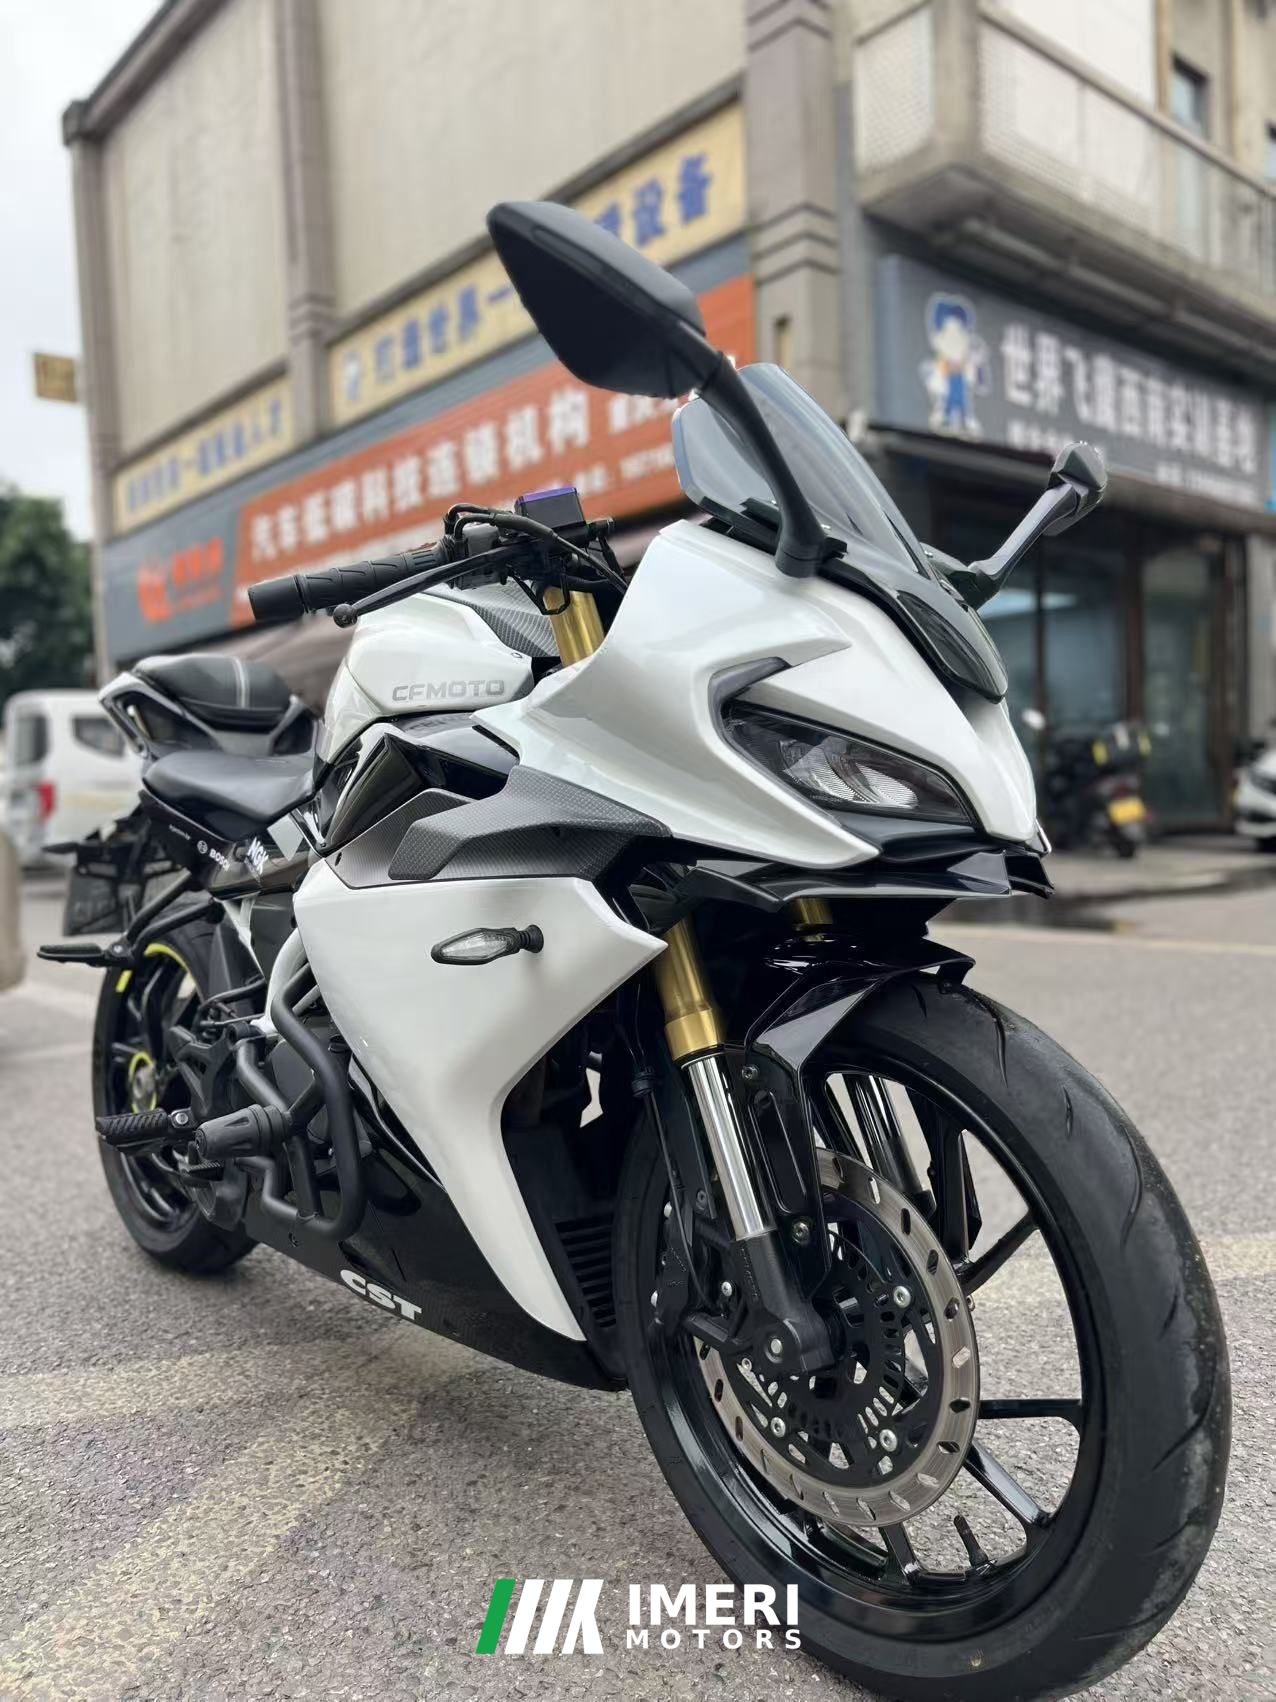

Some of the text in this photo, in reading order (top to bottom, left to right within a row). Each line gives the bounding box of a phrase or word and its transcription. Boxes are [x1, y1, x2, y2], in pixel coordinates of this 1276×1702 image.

[392, 679, 504, 702] CFMOTO
[247, 836, 270, 876] NGK
[340, 1269, 423, 1321] CST
